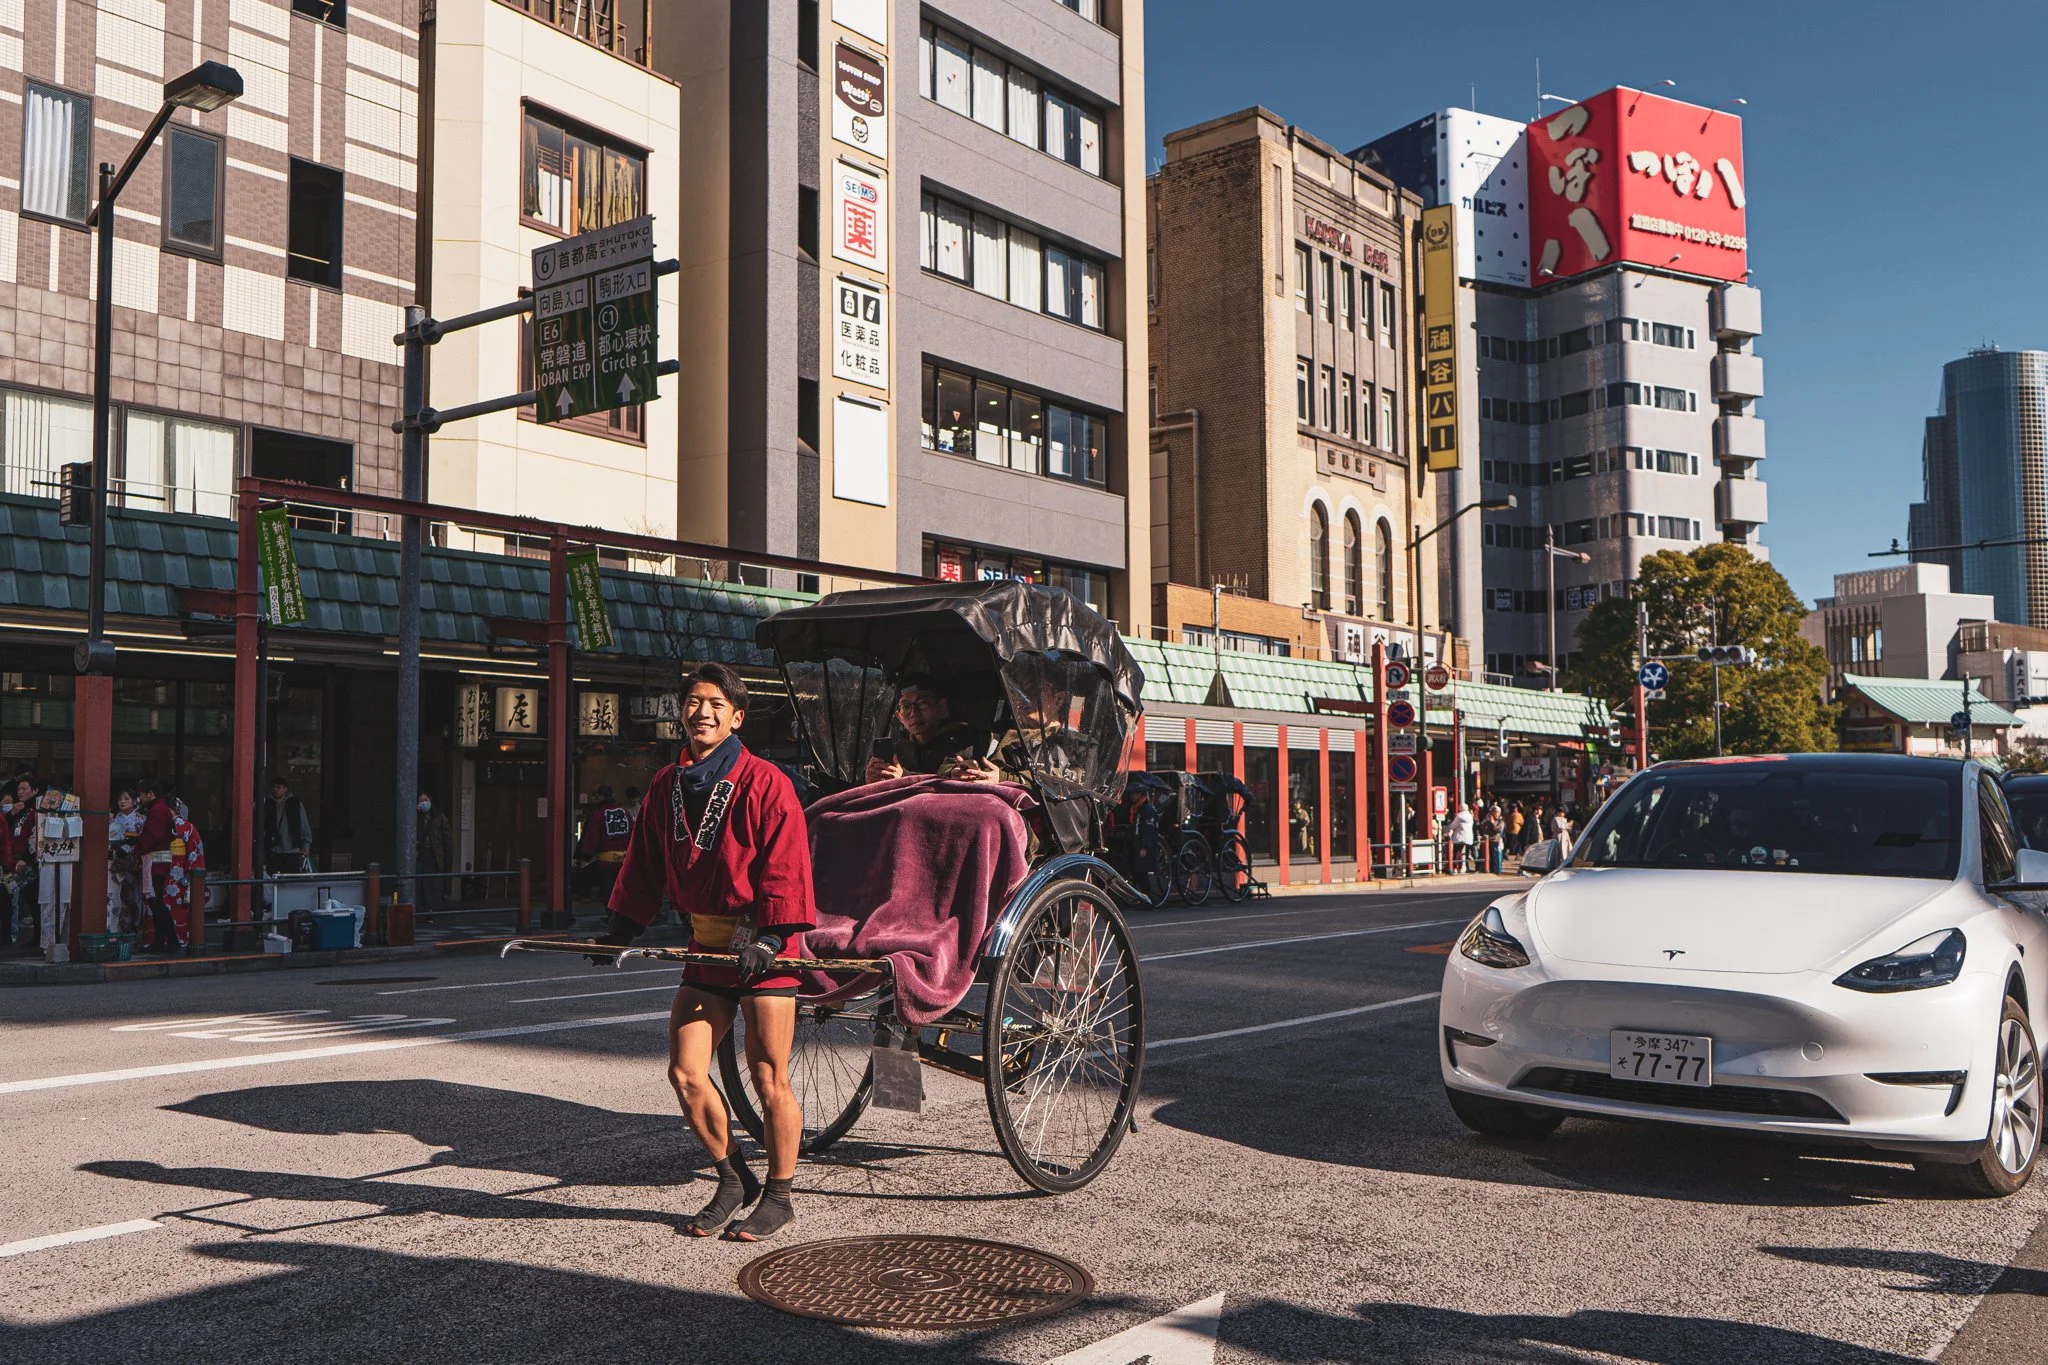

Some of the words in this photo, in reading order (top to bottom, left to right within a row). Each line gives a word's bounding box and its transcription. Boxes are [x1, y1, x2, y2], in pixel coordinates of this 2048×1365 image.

[845, 181, 875, 200] SEIMS
[1537, 106, 1610, 276] つぼ八
[1630, 150, 1746, 209] つぼ八
[1462, 196, 1508, 217] カルピス
[599, 225, 650, 248] SHUTOKO
[847, 207, 873, 251] 薬
[541, 254, 549, 274] 6
[558, 243, 598, 269] 首都高
[600, 271, 647, 299] 駒形入口
[539, 288, 584, 314] 向島入口
[602, 310, 614, 325] C1
[543, 323, 559, 341] E6
[599, 323, 651, 356] 都心環状
[841, 320, 880, 346] 医薬品
[540, 340, 587, 370] 常磐道
[601, 354, 637, 374] Circle
[642, 350, 650, 364] 1
[841, 349, 880, 375] 化粧品
[537, 368, 569, 391] JOBAN
[573, 364, 591, 380] EXP
[1430, 328, 1452, 448] 神谷バー
[272, 520, 298, 620] 新春浅草歌舞伎
[941, 554, 961, 581] 薬
[1344, 628, 1435, 659] 神バー
[1426, 672, 1447, 683] 消火栓
[2015, 658, 2025, 695] 水上バス
[467, 688, 477, 738] おそば
[508, 693, 530, 728] 尾
[592, 697, 613, 731] 張
[1634, 1036, 1660, 1050] 多摩
[1664, 1038, 1689, 1052] 347
[1617, 1056, 1628, 1070] そ
[1632, 1051, 1705, 1081] 77-77
